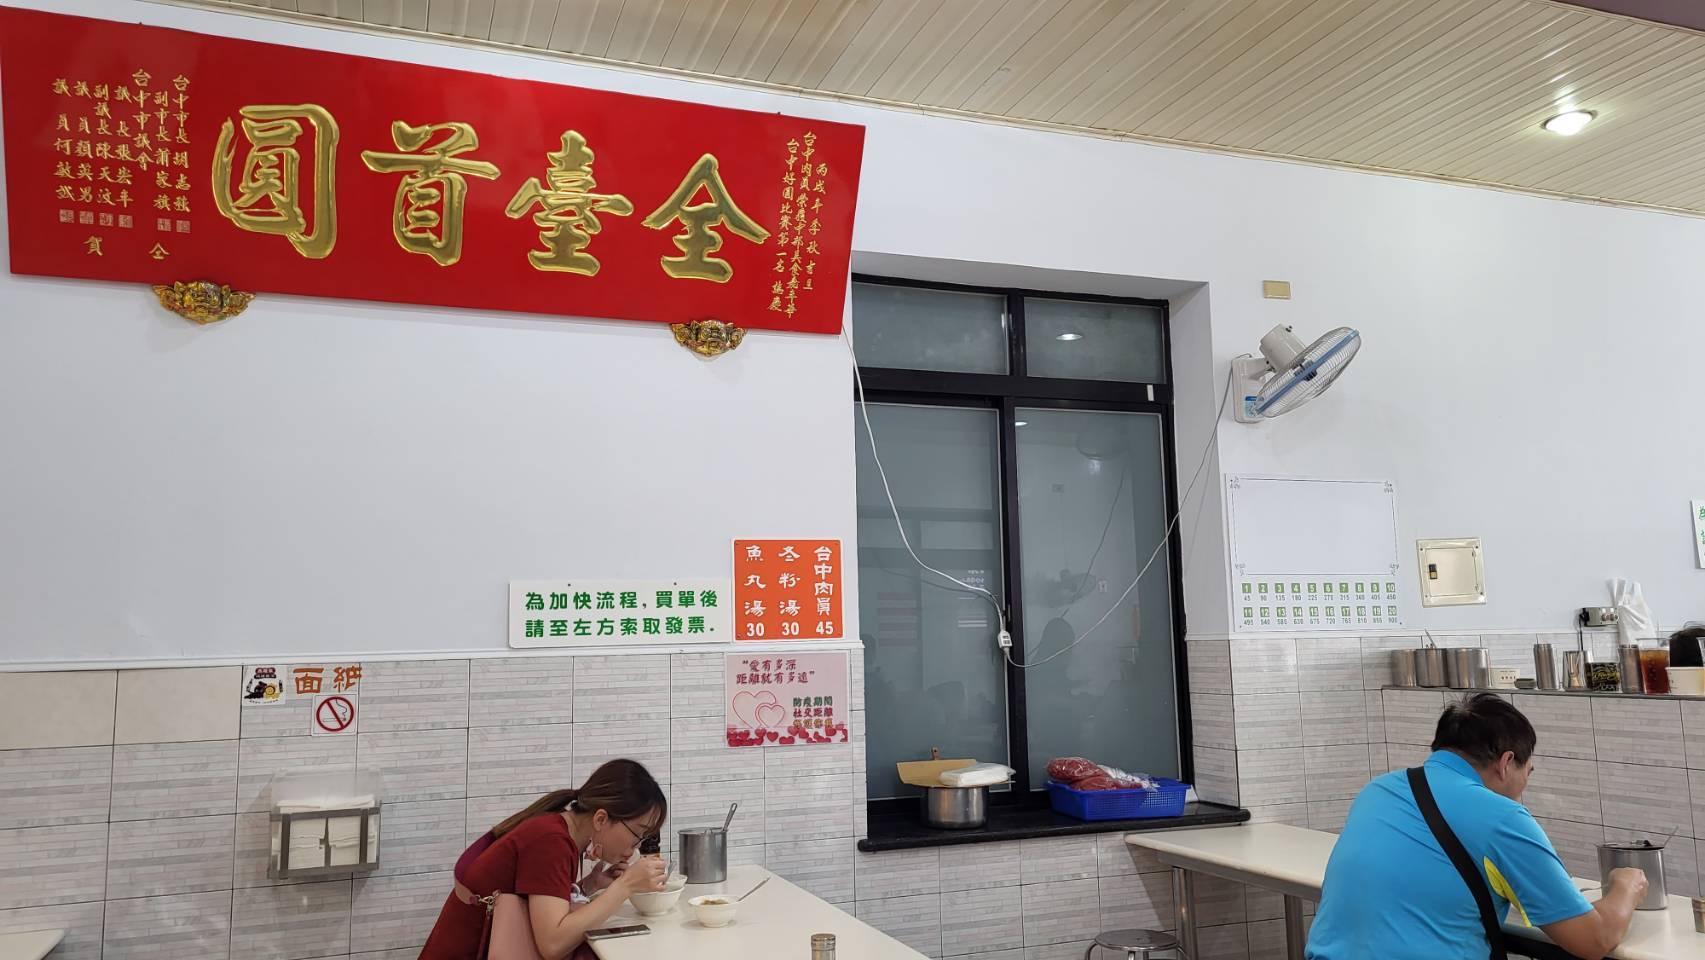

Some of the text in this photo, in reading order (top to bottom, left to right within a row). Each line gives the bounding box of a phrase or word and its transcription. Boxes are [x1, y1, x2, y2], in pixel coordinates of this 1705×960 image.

[744, 545, 766, 617] 魚丸湯
[778, 546, 801, 617] 冬粉湯
[746, 622, 765, 637] 30
[782, 621, 800, 636] 30
[816, 621, 834, 635] 45
